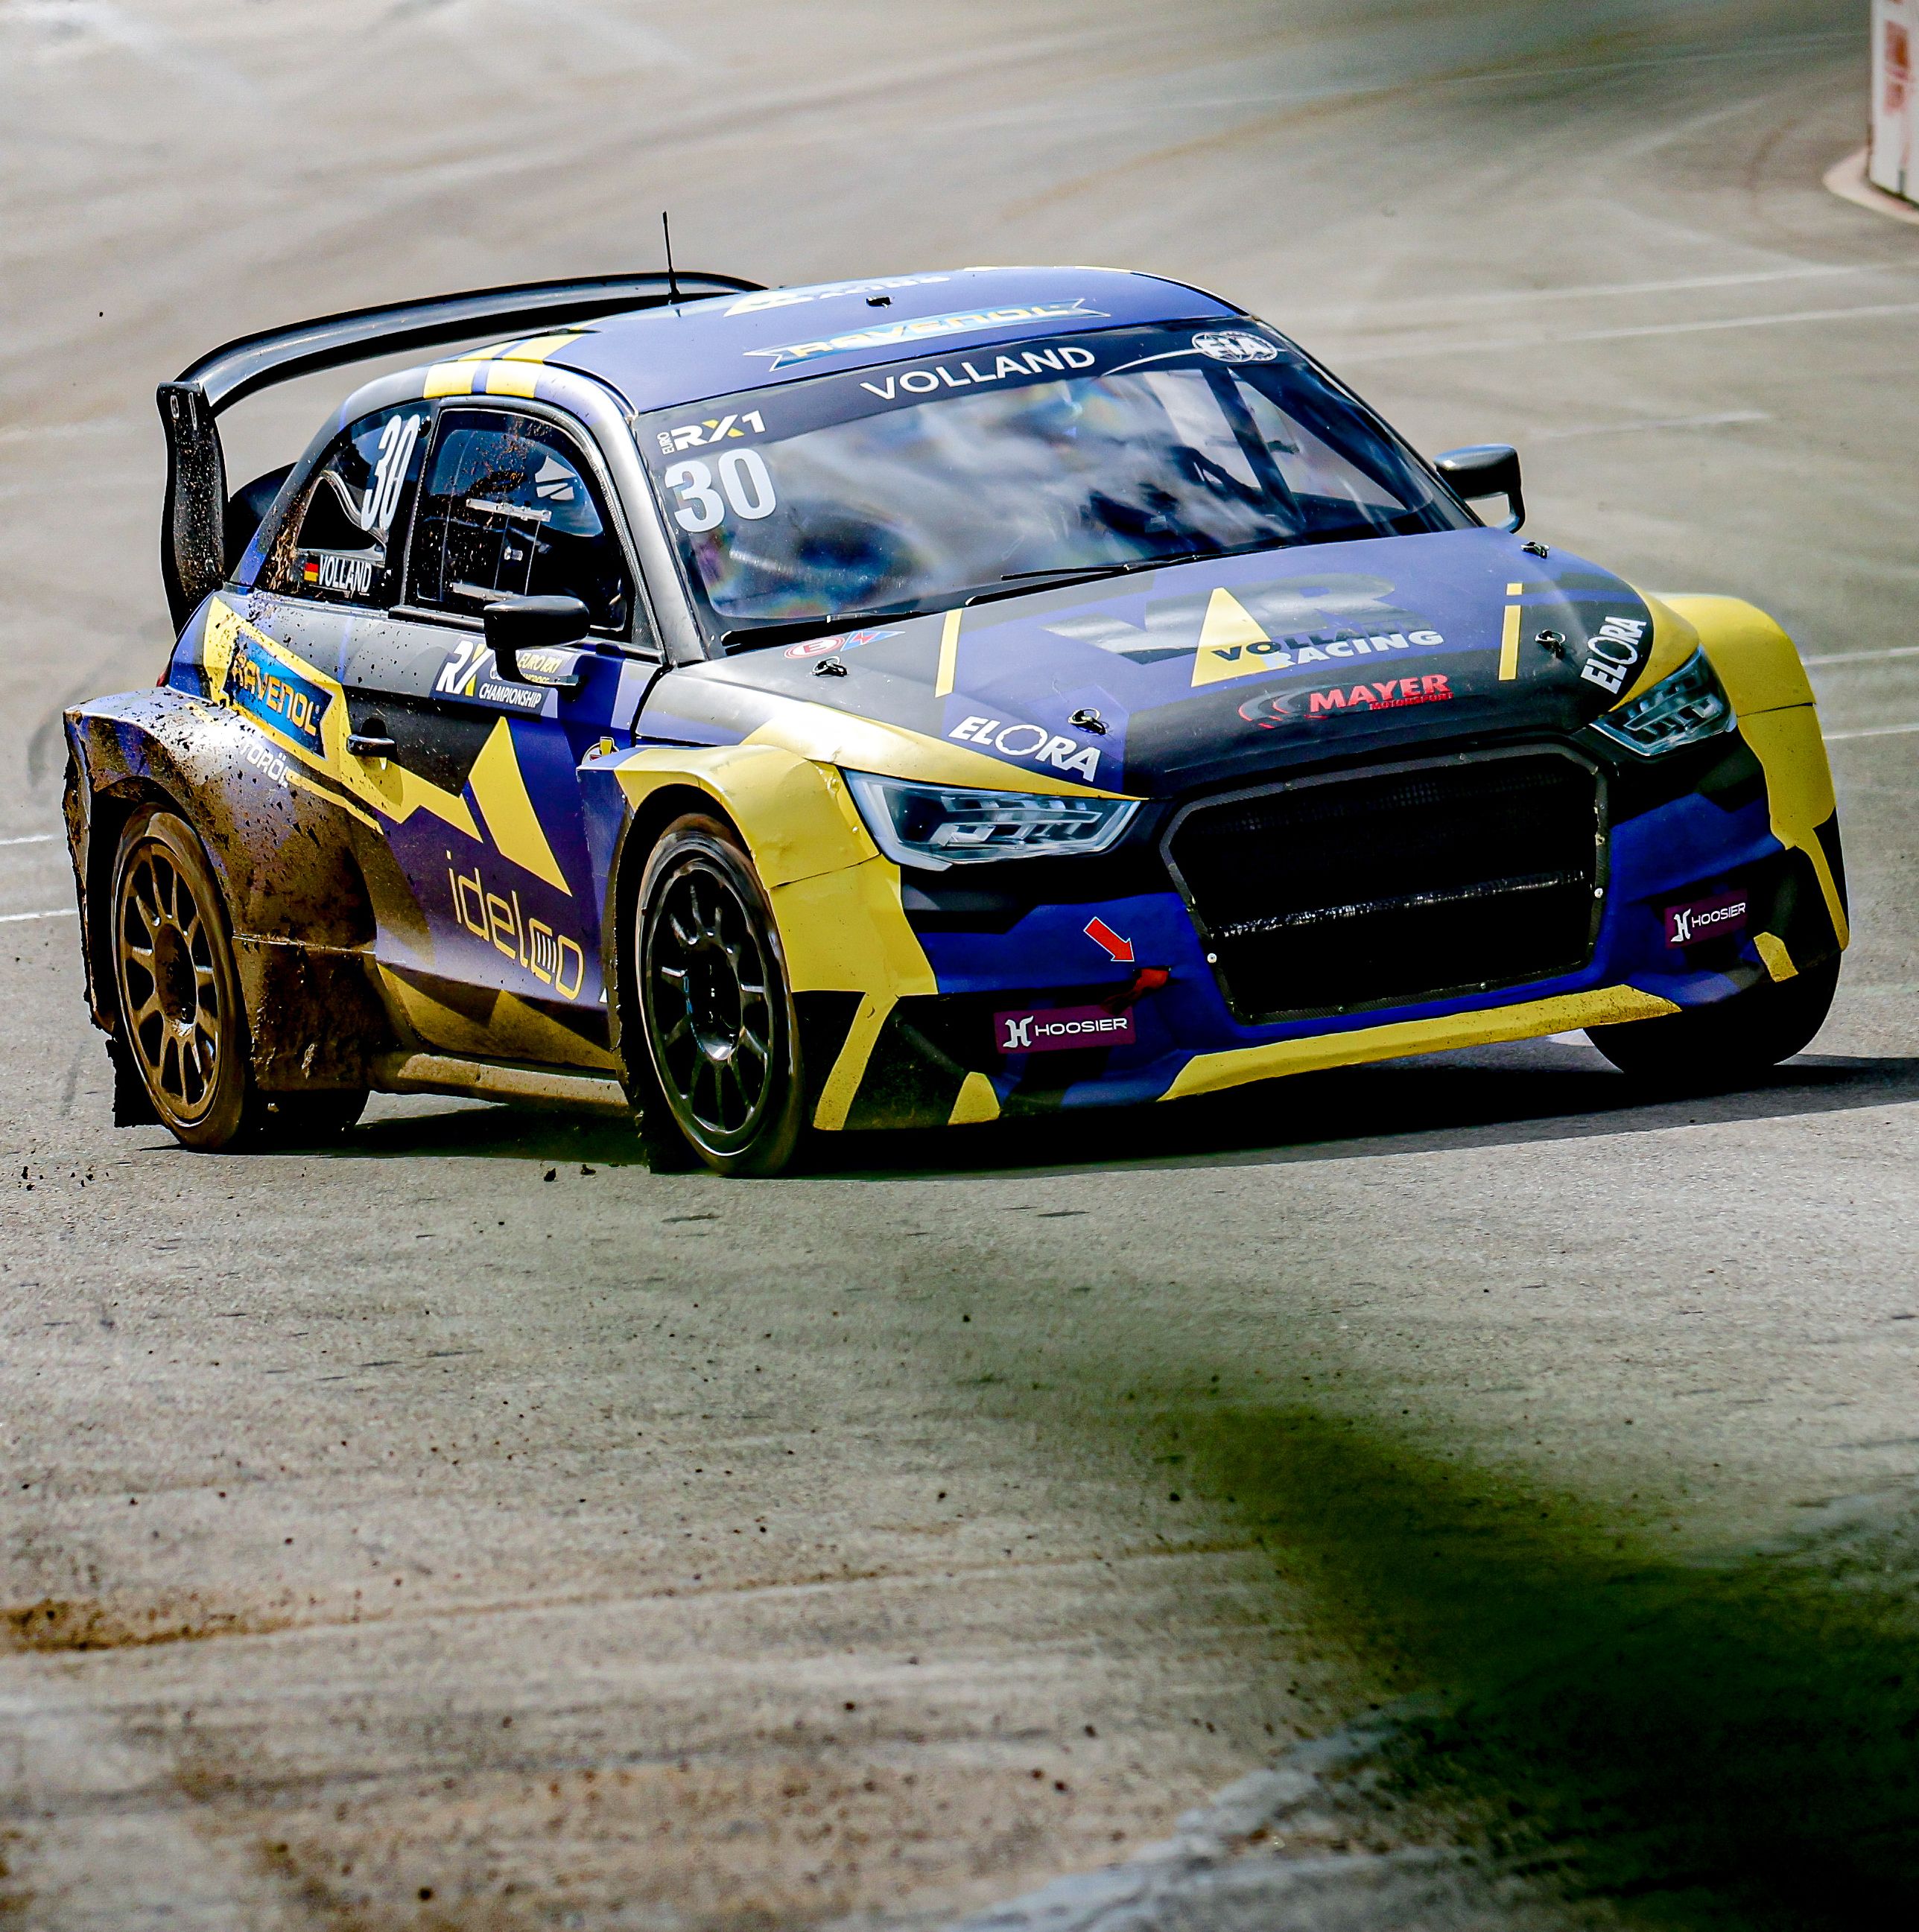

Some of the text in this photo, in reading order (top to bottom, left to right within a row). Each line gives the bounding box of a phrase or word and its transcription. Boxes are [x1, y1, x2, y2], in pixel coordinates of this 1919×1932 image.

[786, 305, 1069, 358] RAVENOL
[1193, 335, 1276, 359] FIA
[859, 346, 1096, 401] VOLLAND
[656, 410, 766, 455] EURO RX1
[361, 414, 420, 531] 30
[664, 448, 776, 533] 30
[319, 554, 372, 593] VOLLAND
[1260, 630, 1444, 668] RACING
[1580, 616, 1647, 694] ELORA
[232, 650, 317, 737] RAVENOL
[479, 682, 542, 708] CHAMPIONSHIP
[1310, 673, 1452, 713] MAYER
[948, 716, 1101, 782] ELORA
[1691, 902, 1746, 928] HOOSIER
[1035, 1017, 1128, 1036] HOOSIER
